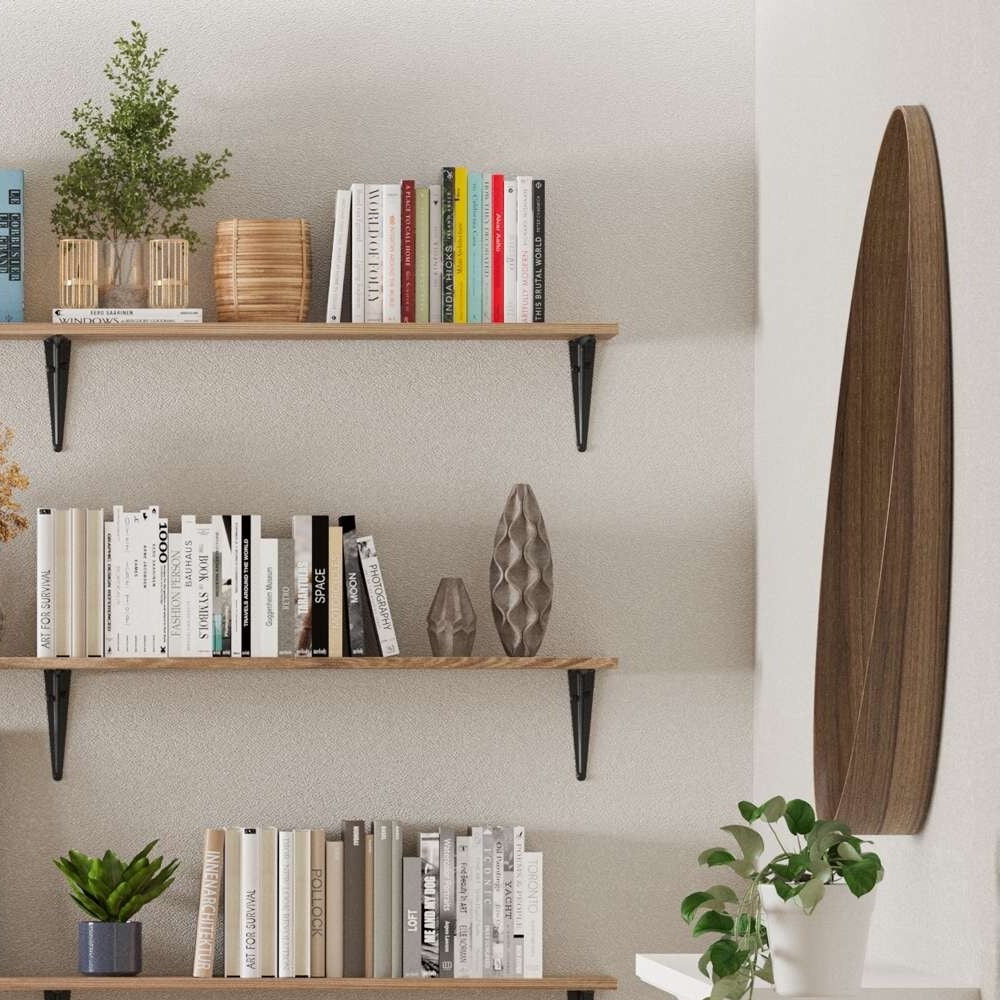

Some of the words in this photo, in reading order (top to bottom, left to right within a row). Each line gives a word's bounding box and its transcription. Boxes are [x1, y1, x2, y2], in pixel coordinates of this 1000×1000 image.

[9, 190, 21, 204] LE
[368, 189, 380, 238] WORLD
[405, 215, 411, 225] TO
[368, 242, 380, 256] OF
[444, 245, 452, 281] HICKS
[368, 263, 380, 302] FOLLY
[444, 283, 452, 315] INDIA
[159, 522, 168, 564] 1000
[170, 550, 181, 589] PERSON
[184, 540, 192, 588] BAUHAUS
[198, 555, 209, 582] BOOK
[40, 569, 51, 609] SURVIVAL
[282, 586, 290, 610] RETRO
[315, 568, 326, 604] SPACE
[348, 573, 359, 603] MOON
[369, 564, 392, 630] PHOTOGRAPHY
[40, 612, 51, 629] FOR
[170, 592, 181, 636] FASHION
[198, 592, 209, 640] SYMBOLS
[265, 591, 274, 627] Guggenheim
[40, 633, 51, 649] ART
[424, 875, 436, 895] DOG
[484, 848, 492, 905] ICONIC
[528, 859, 538, 913] TORONTO
[197, 850, 221, 970] INNENARCHITEKTUR
[245, 889, 256, 929] SURVIVAL
[311, 869, 323, 937] POLLOCK
[424, 895, 436, 910] MY
[460, 902, 468, 913] ART
[504, 880, 512, 920] YACHT
[408, 909, 418, 932] LOFT
[424, 910, 436, 929] AND
[424, 929, 436, 943] ME
[459, 925, 468, 937] ELLE
[245, 931, 256, 950] FOR
[245, 952, 256, 969] ART
